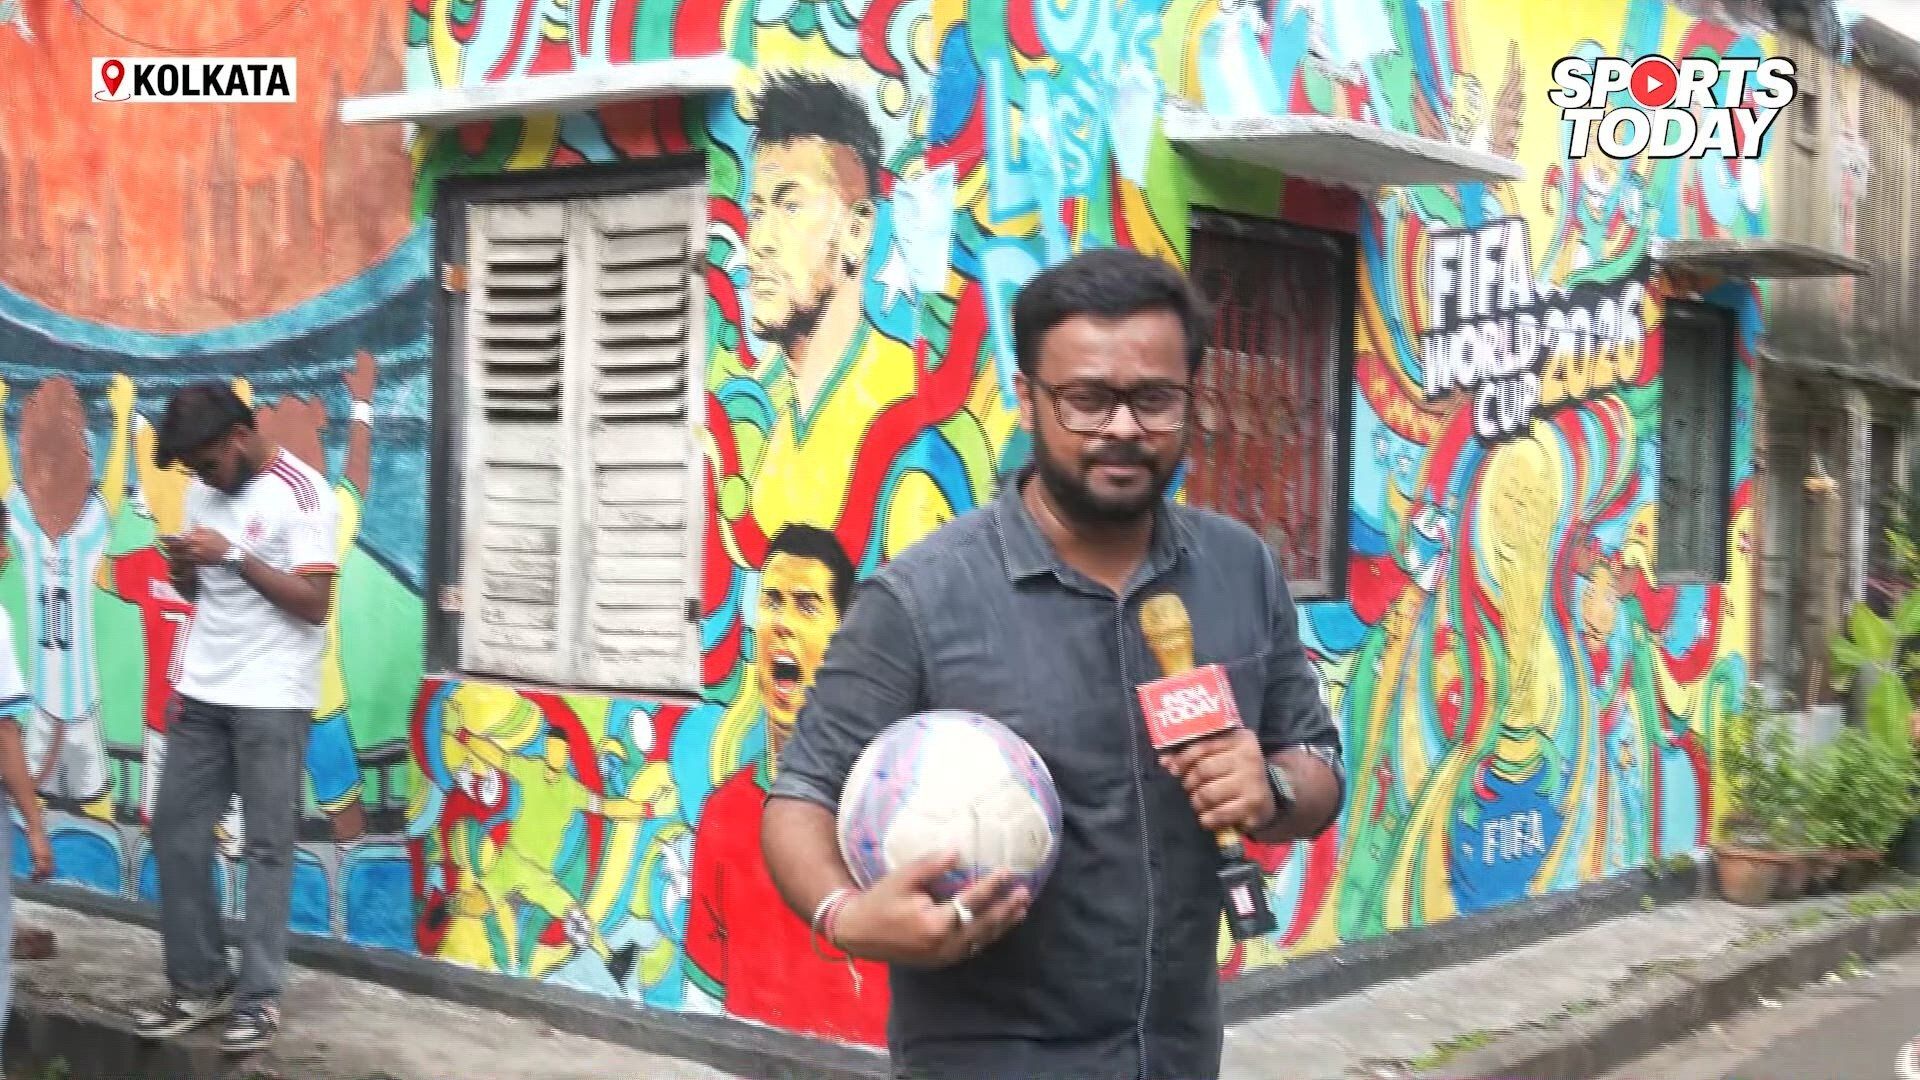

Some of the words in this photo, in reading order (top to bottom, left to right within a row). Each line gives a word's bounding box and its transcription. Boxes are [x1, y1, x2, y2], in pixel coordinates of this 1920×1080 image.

[1428, 217, 1536, 331] FIFA
[1421, 312, 1541, 397] WORLD
[1540, 280, 1646, 408] 2026
[1474, 371, 1541, 438] CUP
[38, 585, 74, 651] 10
[1155, 693, 1220, 728] TODAY
[1481, 809, 1547, 865] FIFA
